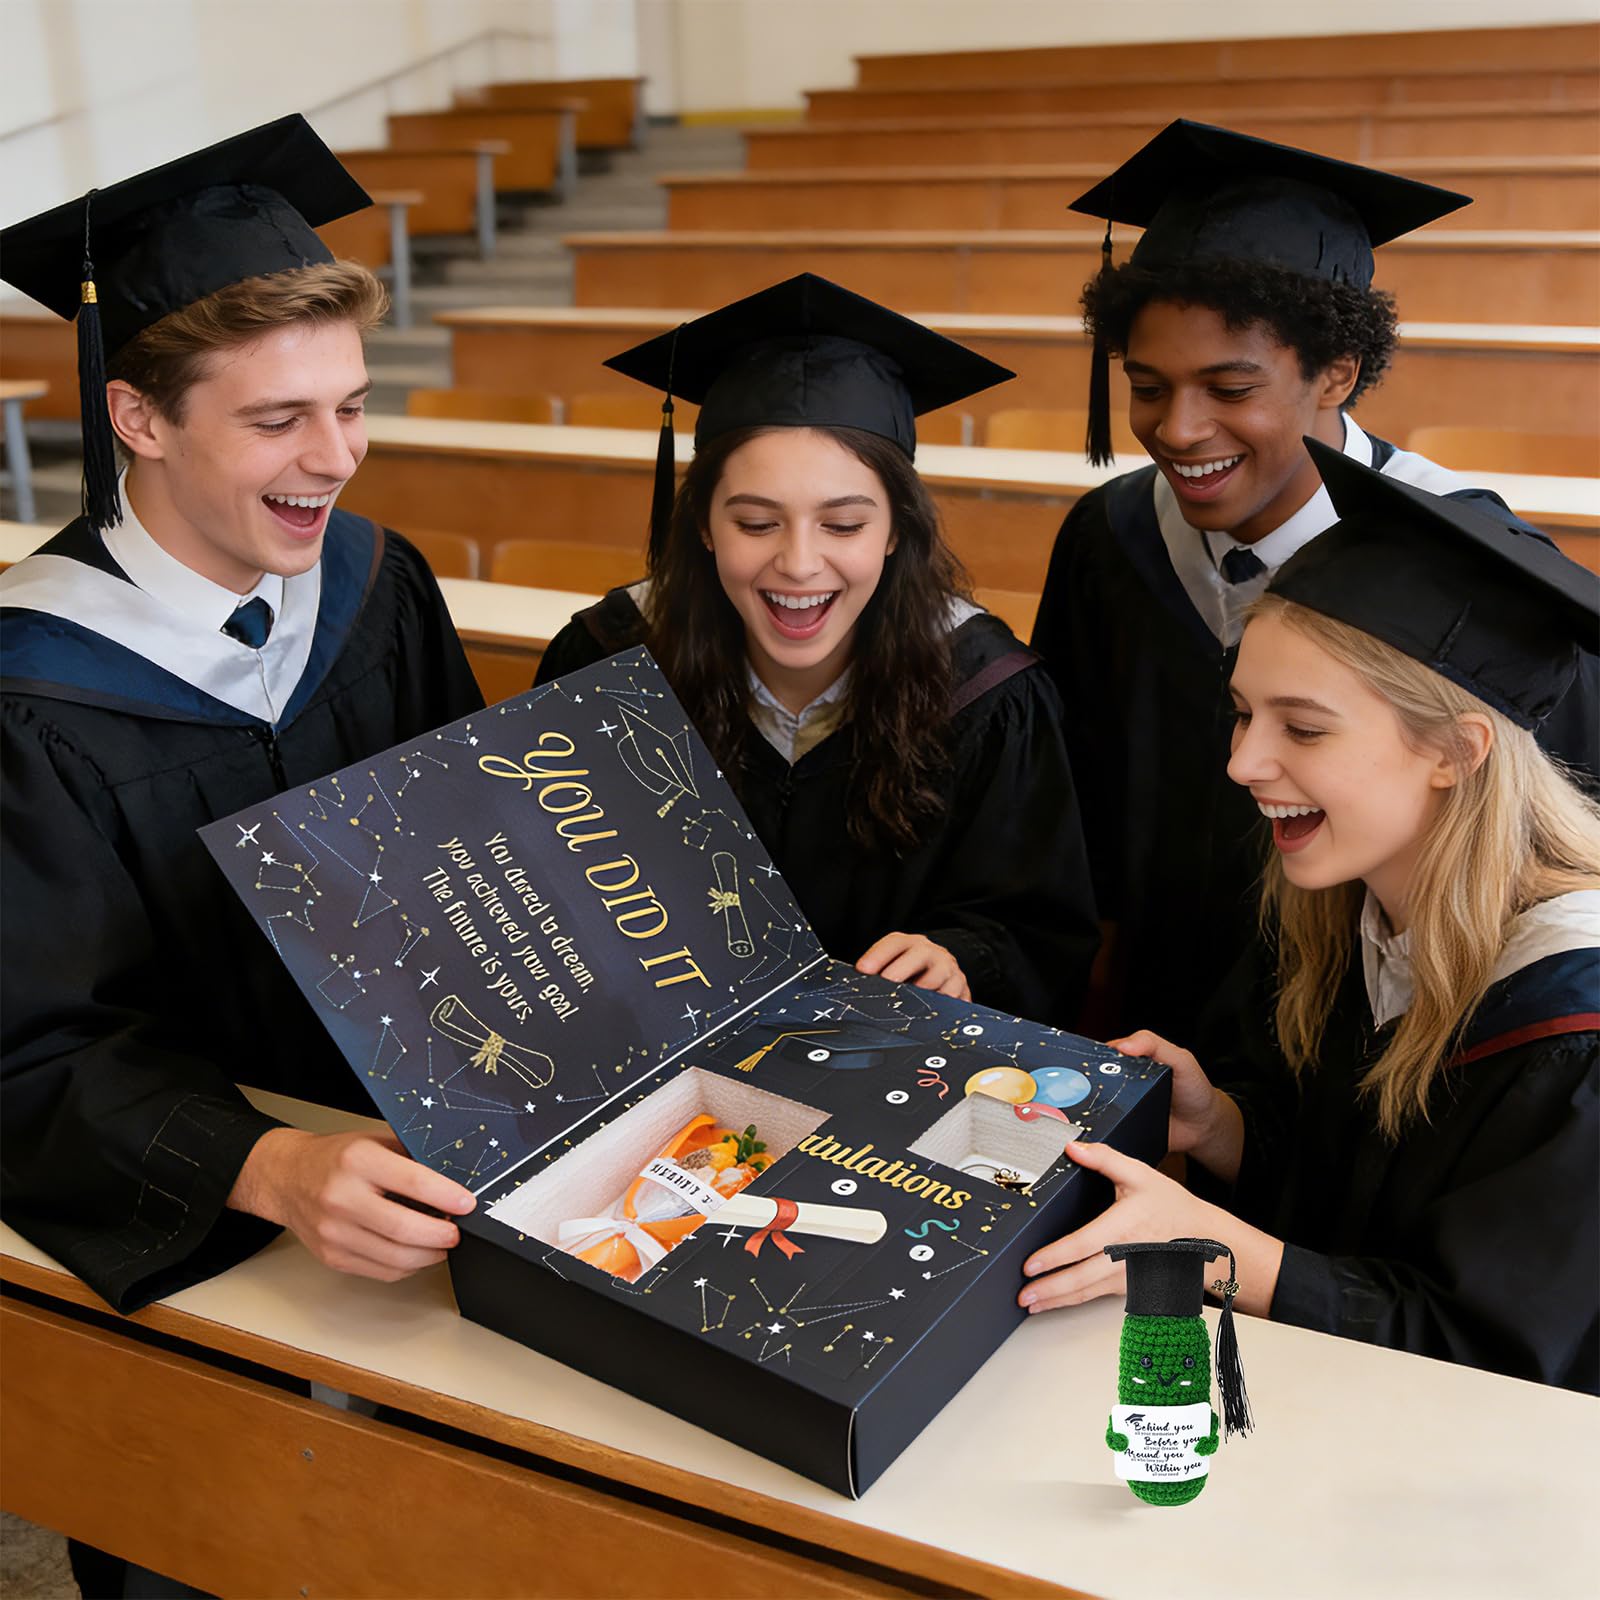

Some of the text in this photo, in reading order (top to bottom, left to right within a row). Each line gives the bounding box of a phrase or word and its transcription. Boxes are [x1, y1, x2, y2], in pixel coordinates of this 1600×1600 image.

[585, 853, 669, 939] DID
[639, 945, 712, 988] IT
[481, 952, 502, 975] is
[551, 936, 594, 994] dream,
[1133, 1421, 1194, 1436] Behind you
[1144, 1436, 1200, 1448] Before you
[1124, 1448, 1184, 1462] Around you
[1145, 1461, 1202, 1475] Within you
